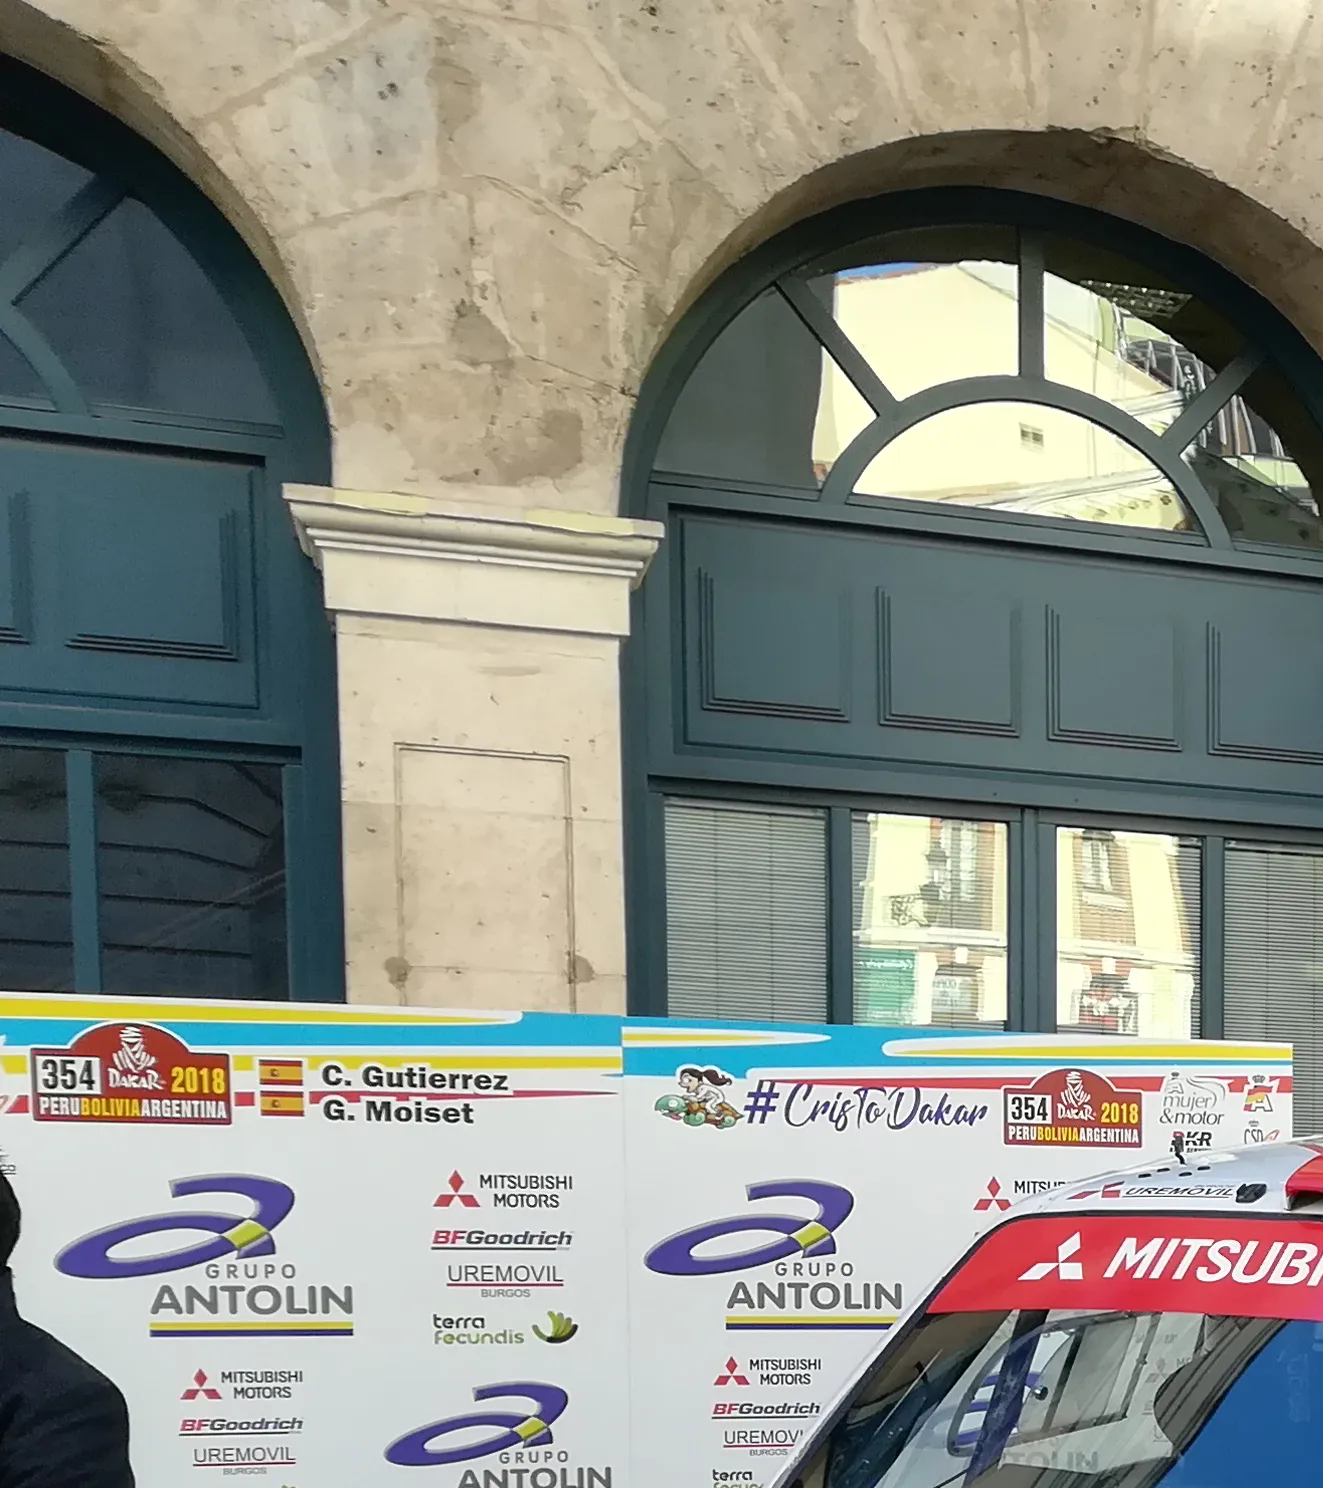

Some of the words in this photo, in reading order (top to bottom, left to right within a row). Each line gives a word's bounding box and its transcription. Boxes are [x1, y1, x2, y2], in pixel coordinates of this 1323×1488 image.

[41, 1059, 96, 1092] 354
[171, 1067, 226, 1095] 2018
[322, 1065, 353, 1087] C.
[362, 1066, 509, 1091] Gutierrez
[1163, 1092, 1213, 1111] mujer
[323, 1101, 355, 1123] G.
[367, 1102, 474, 1124] Moiset
[1011, 1095, 1049, 1121] 354
[1101, 1102, 1140, 1125] 2018
[1159, 1108, 1225, 1125] &motor
[480, 1174, 574, 1190] MITSUBISHI
[1125, 1186, 1235, 1197] UREMOVIL
[494, 1194, 560, 1209] MOTORS
[432, 1230, 573, 1247] BFGoodrich
[206, 1264, 297, 1279] GRUPO
[447, 1265, 565, 1283] UREMOVIL
[775, 1262, 854, 1277] GRUPO
[150, 1285, 354, 1315] ANTOLIN
[481, 1289, 531, 1298] BURGOS
[726, 1282, 903, 1310] ANTOLIN
[433, 1313, 486, 1330] terra
[434, 1329, 525, 1345] fecundis
[749, 1358, 822, 1371] MITSUBISHI
[221, 1371, 303, 1384] MITSUBISHI
[760, 1374, 811, 1386] MOTORS
[234, 1386, 292, 1399] MOTORS
[713, 1402, 821, 1416] BFGoodrich
[180, 1417, 304, 1433] BFGoodrich
[724, 1430, 803, 1445] UREMOV
[194, 1447, 296, 1463] UREMOVIL
[500, 1450, 569, 1465] GRUPO
[712, 1469, 753, 1481] terra
